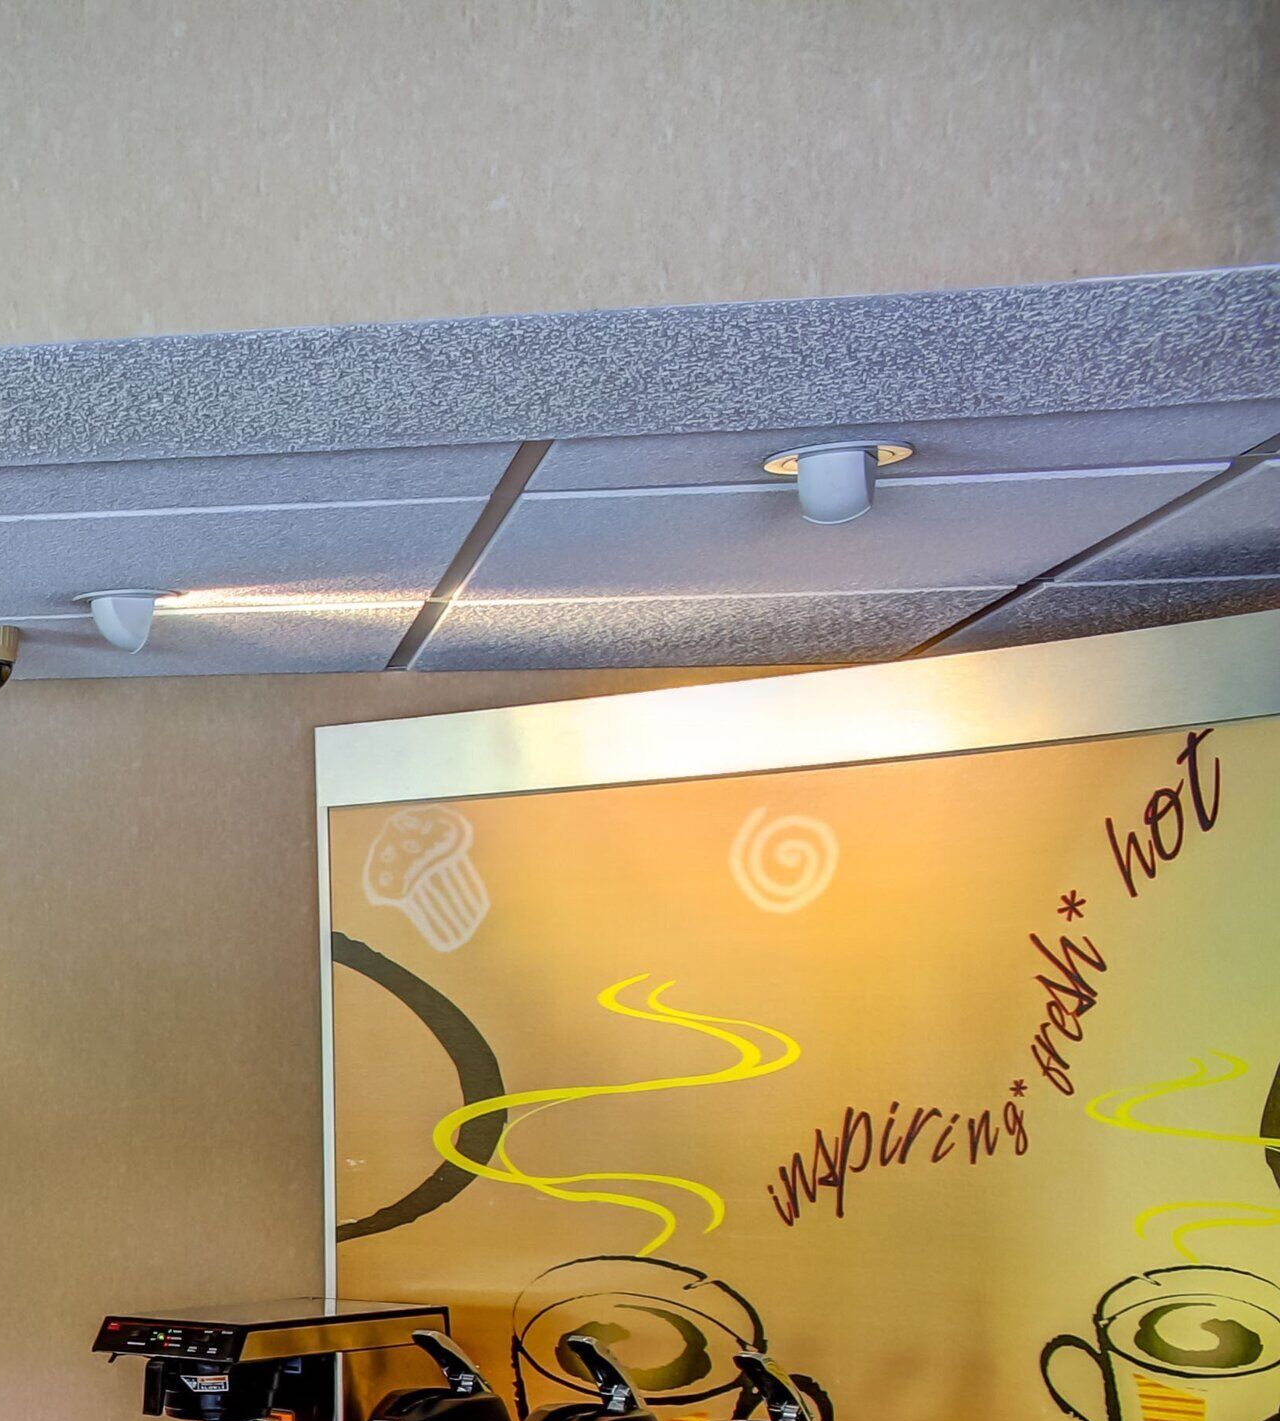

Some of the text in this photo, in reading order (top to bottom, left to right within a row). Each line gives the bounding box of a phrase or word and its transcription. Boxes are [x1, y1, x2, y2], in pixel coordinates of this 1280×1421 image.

[767, 727, 1221, 1227] inspiring fresh hot
